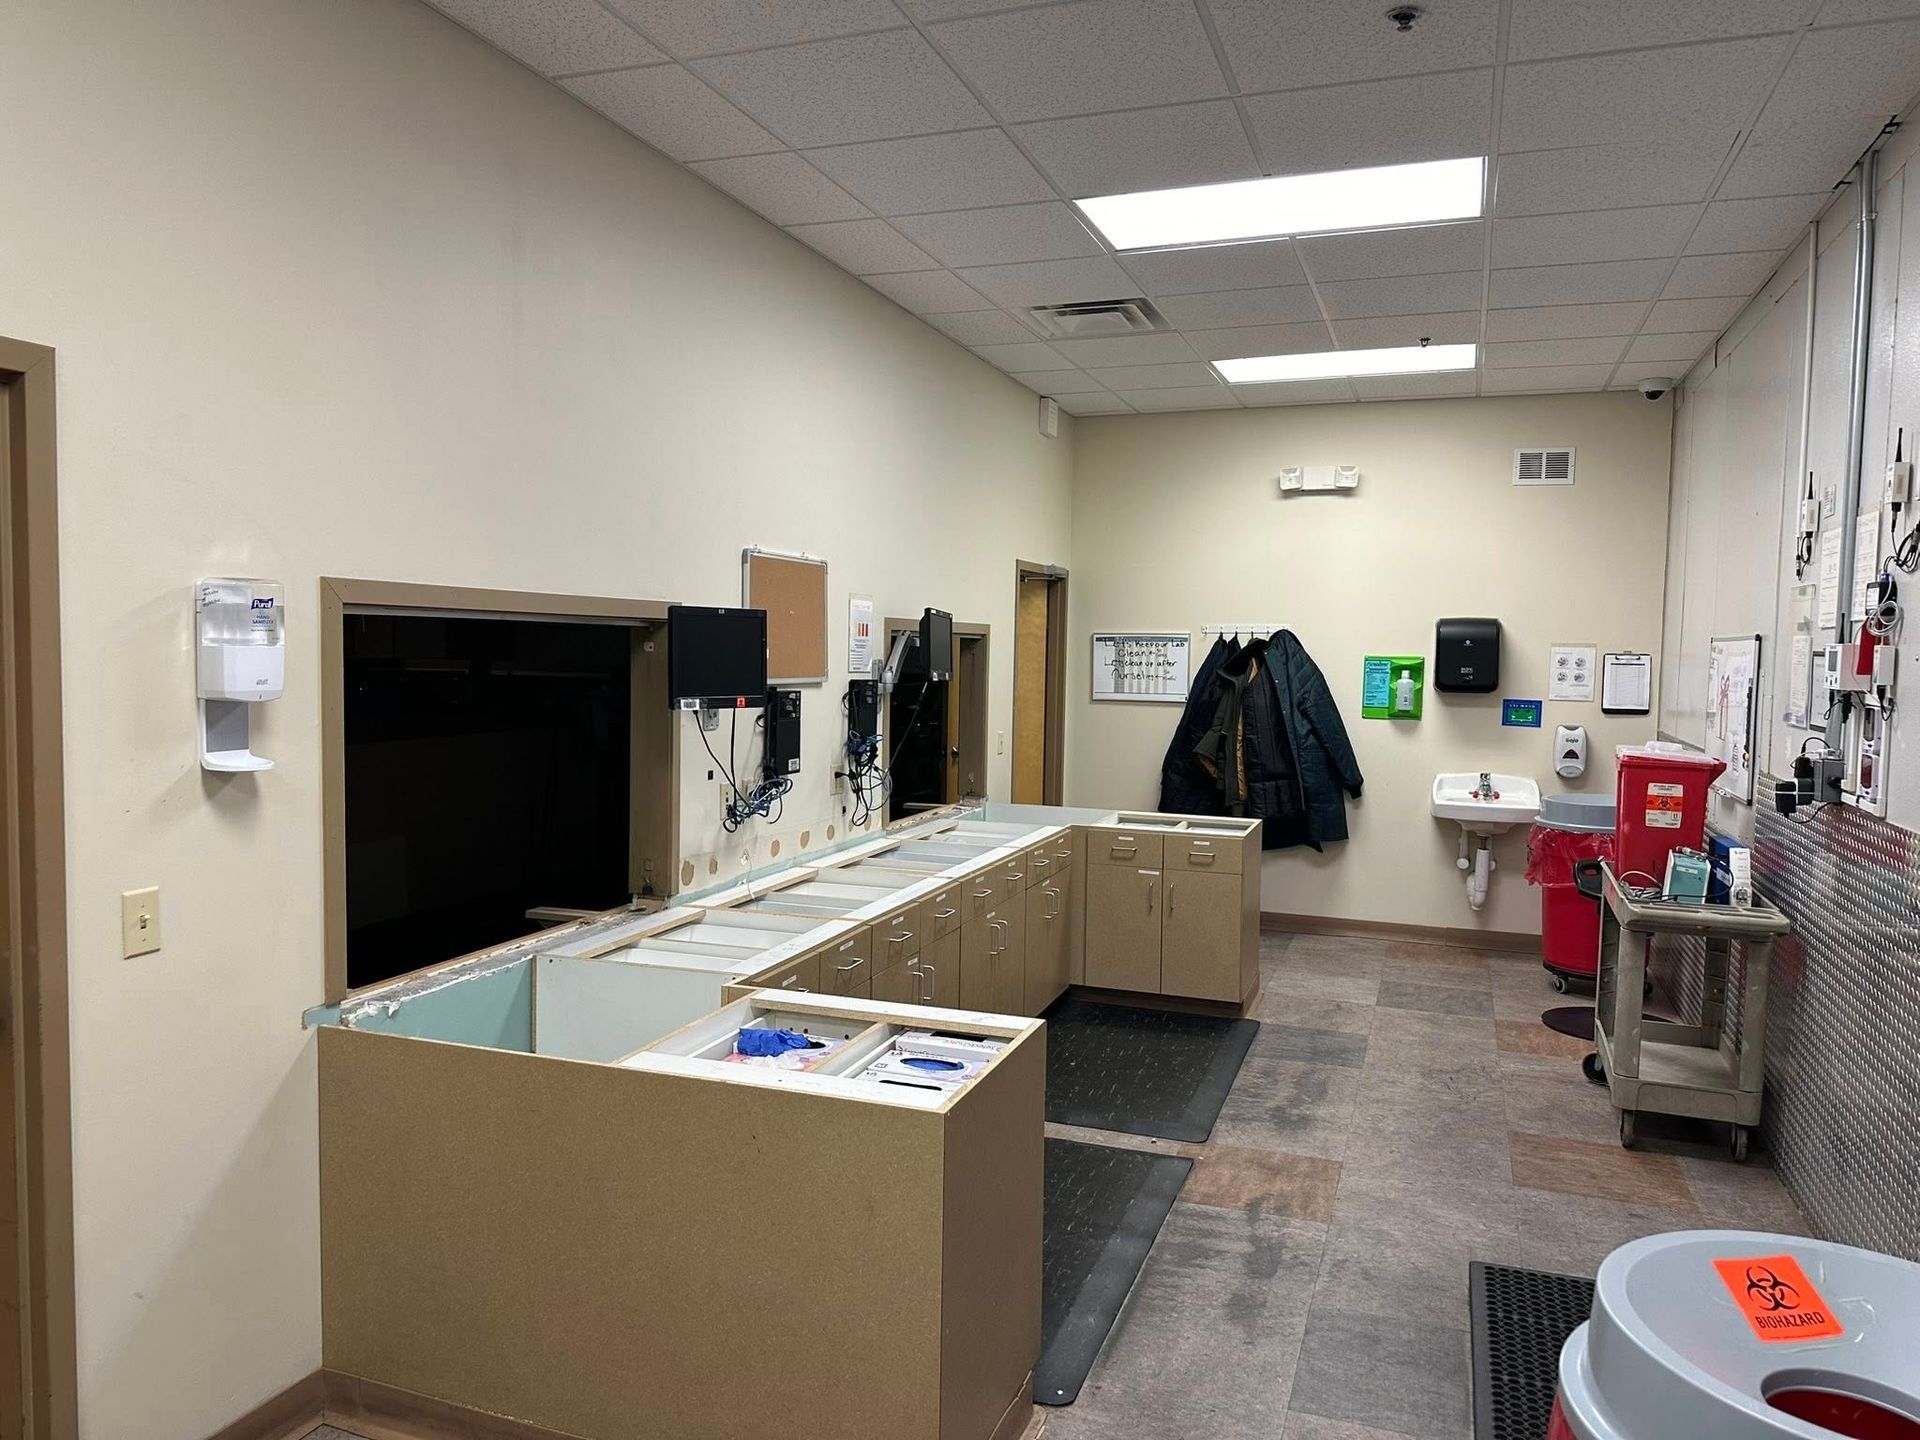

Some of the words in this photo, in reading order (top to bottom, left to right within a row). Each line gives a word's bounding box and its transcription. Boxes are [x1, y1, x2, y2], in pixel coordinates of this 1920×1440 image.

[1171, 639, 1185, 648] Lab
[1156, 659, 1177, 667] after
[1755, 1312, 1826, 1329] BIOHAZARD
